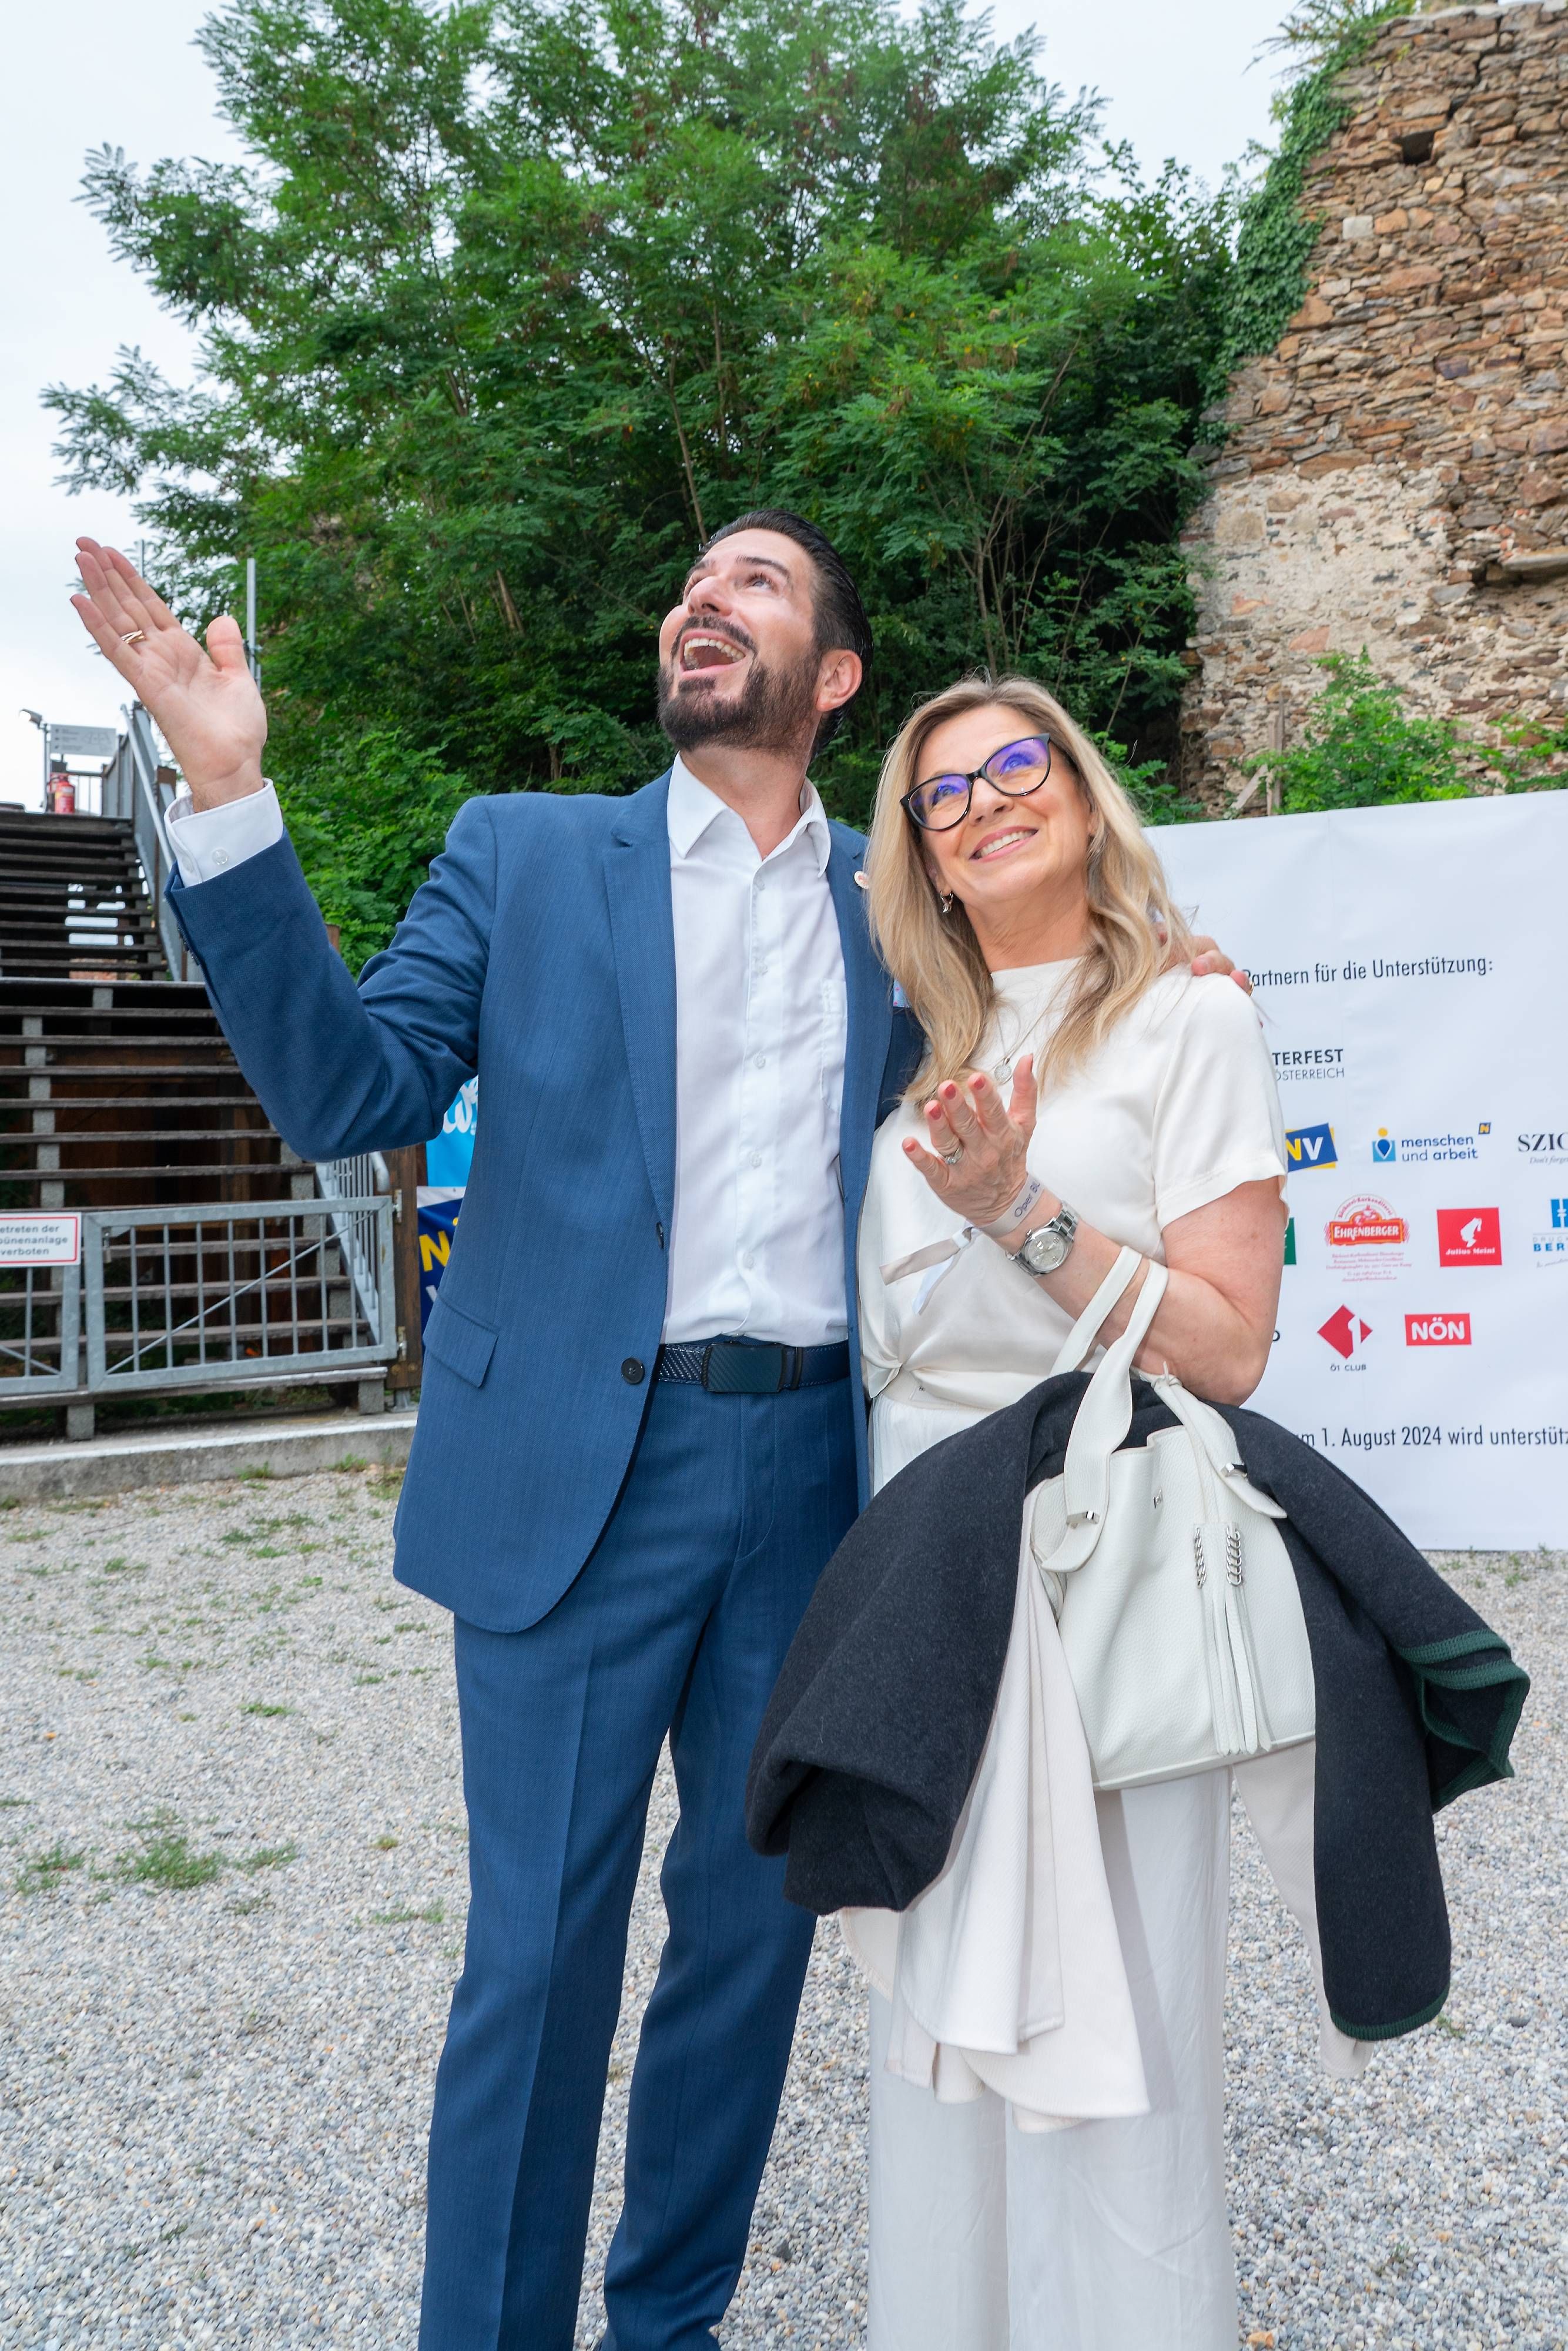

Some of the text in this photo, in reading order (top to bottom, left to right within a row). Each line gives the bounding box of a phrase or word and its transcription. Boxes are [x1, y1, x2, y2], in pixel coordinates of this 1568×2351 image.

[1315, 963, 1337, 983] für
[1343, 960, 1367, 980] die
[1372, 956, 1493, 978] Unterstützung:
[1272, 1049, 1343, 1066] TERFEST
[1401, 1134, 1474, 1148] menschen
[1402, 1147, 1479, 1162] und arbeit
[41, 1225, 59, 1233] der
[1, 1247, 50, 1255] verboten
[1411, 1317, 1465, 1341] NÖN
[1344, 1363, 1367, 1371] CLUB
[1322, 1427, 1335, 1446] 1.
[1341, 1427, 1396, 1451] August
[1401, 1426, 1442, 1445] 2024
[1448, 1425, 1483, 1445] wird
